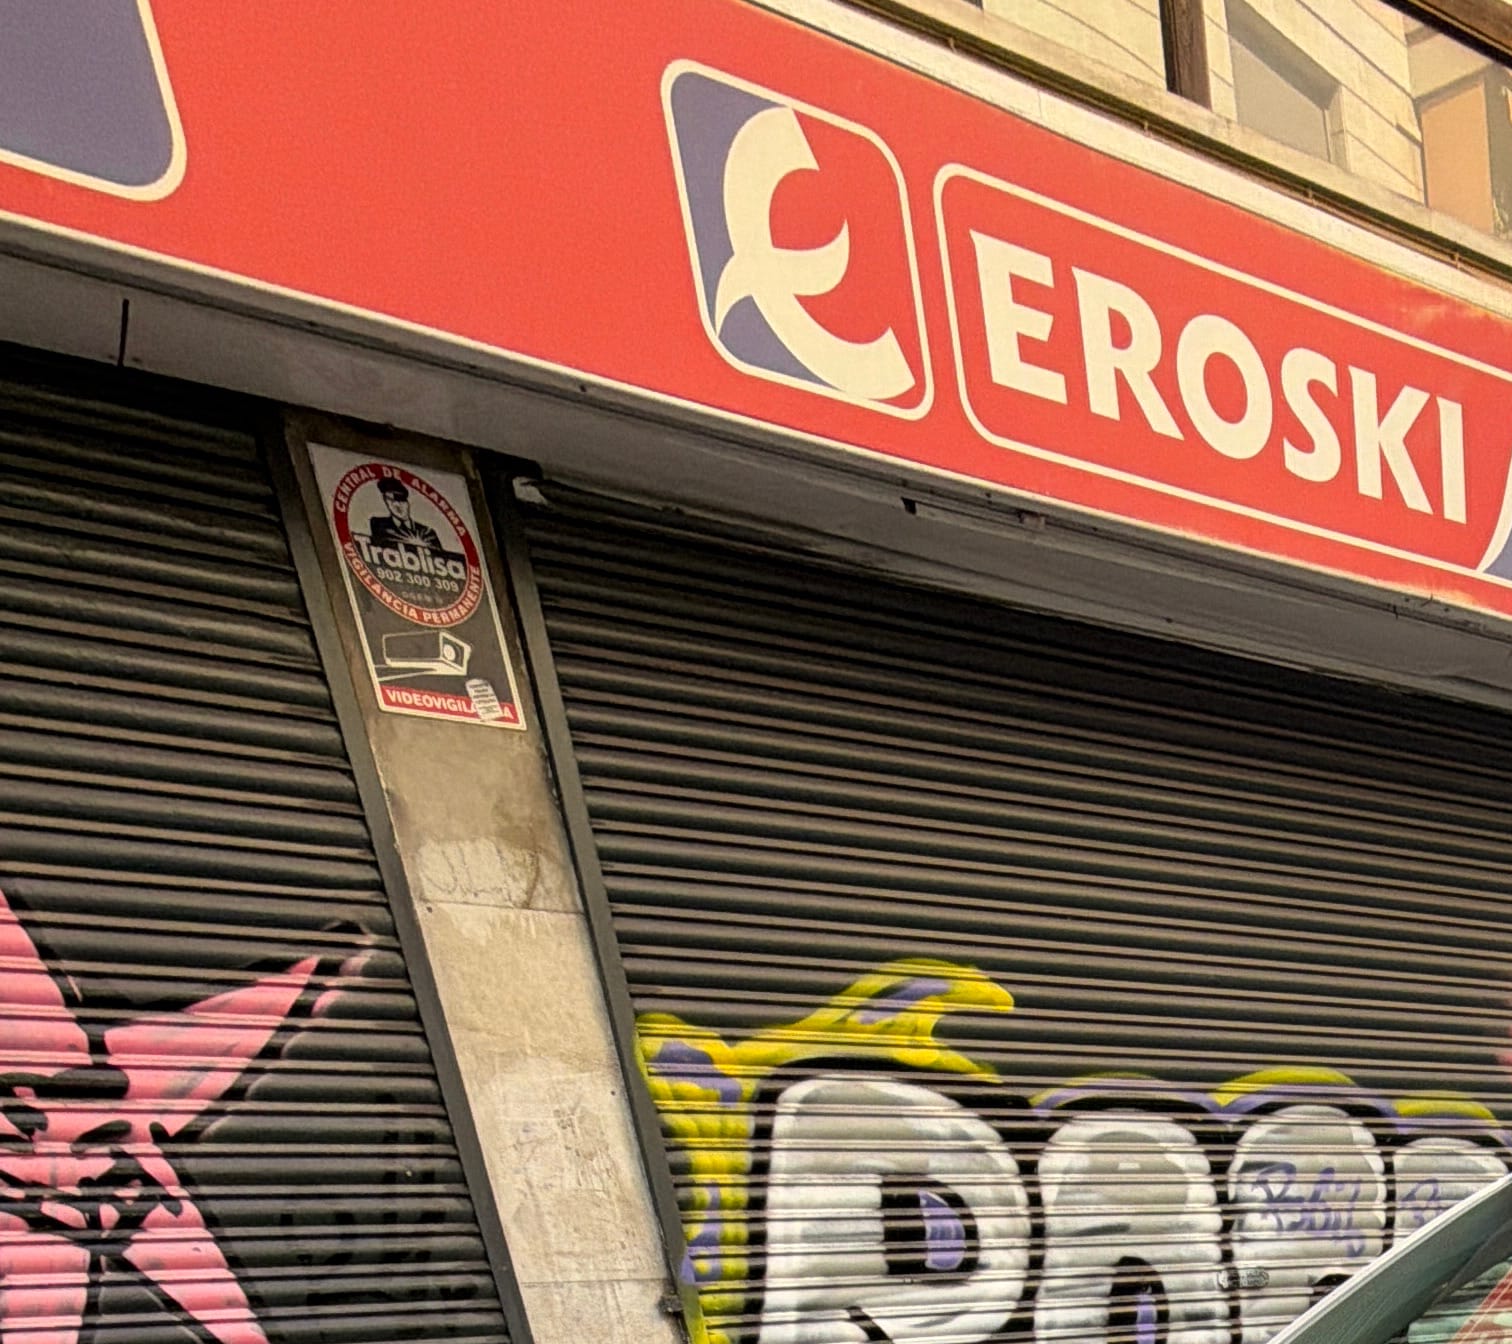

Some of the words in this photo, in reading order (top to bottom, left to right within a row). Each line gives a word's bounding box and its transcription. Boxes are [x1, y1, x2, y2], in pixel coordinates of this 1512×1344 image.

[970, 228, 1468, 525] EROSKI
[335, 466, 376, 513] CENTRAL
[381, 466, 401, 480] DE
[410, 478, 467, 536] ALARMA
[343, 541, 418, 620] VIGILANCIA
[422, 564, 481, 624] PERMANENTE
[354, 534, 467, 580] Trablisa
[376, 566, 403, 585] 902
[405, 573, 431, 588] 300
[435, 579, 459, 593] 309
[385, 688, 515, 720] VIDEOVIGILAA
